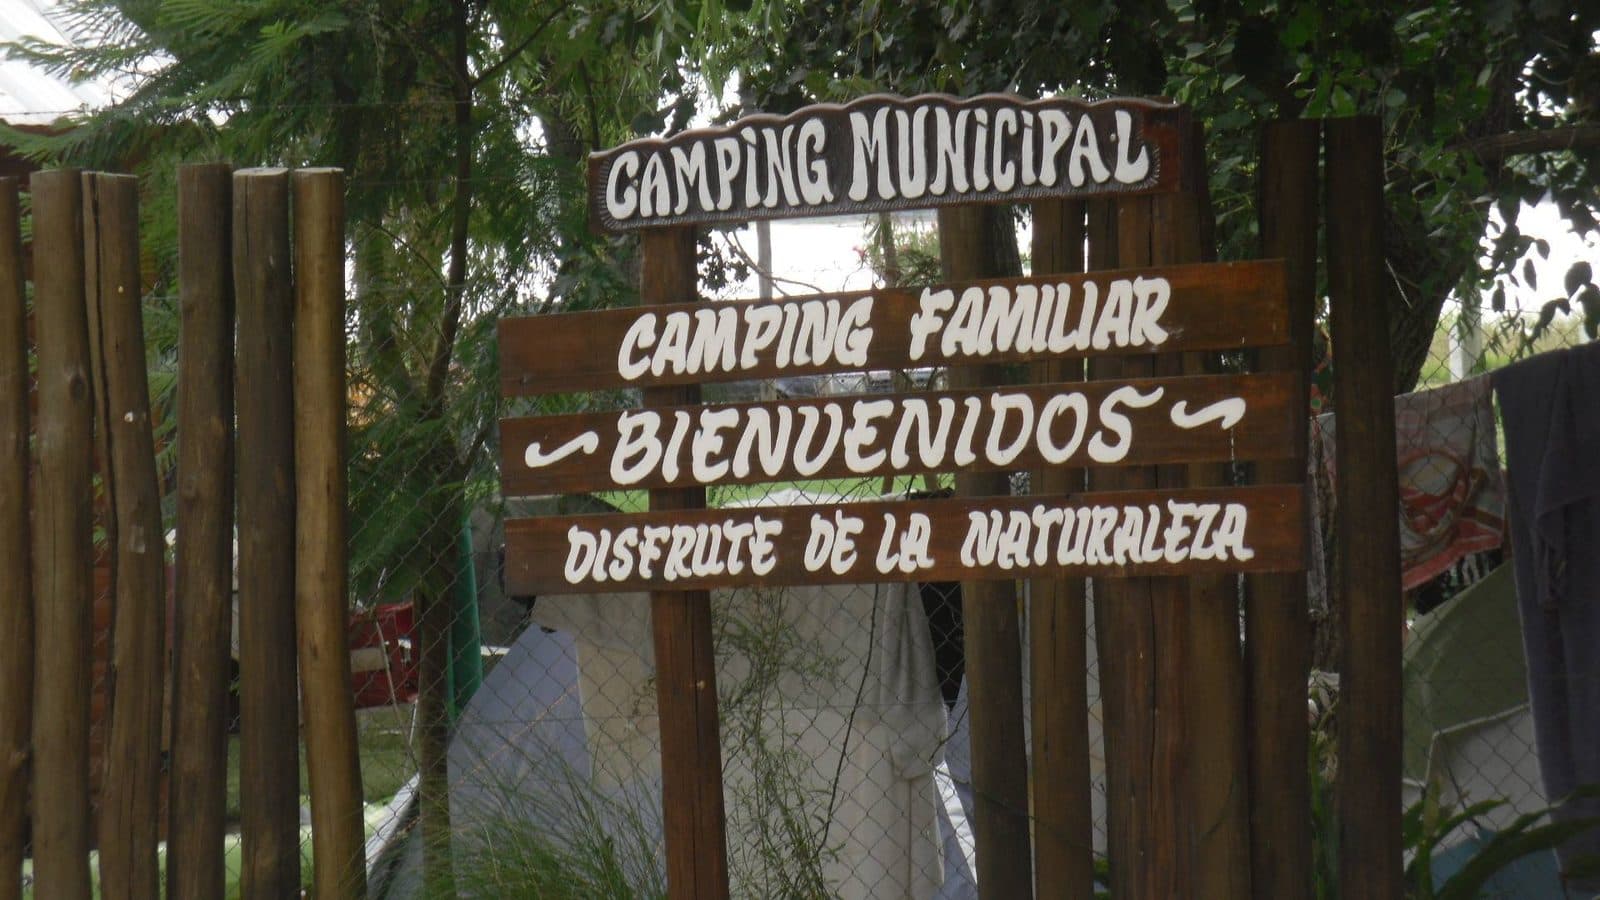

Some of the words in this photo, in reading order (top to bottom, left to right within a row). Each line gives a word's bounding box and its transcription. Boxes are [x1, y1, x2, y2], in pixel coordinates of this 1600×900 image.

[617, 296, 875, 381] CAMPING
[908, 276, 1171, 361] FAMILIAR
[563, 516, 784, 584] DISFRUTE
[803, 510, 864, 575] DE
[876, 511, 935, 575] LA
[960, 500, 1255, 570] NATURALEZA
